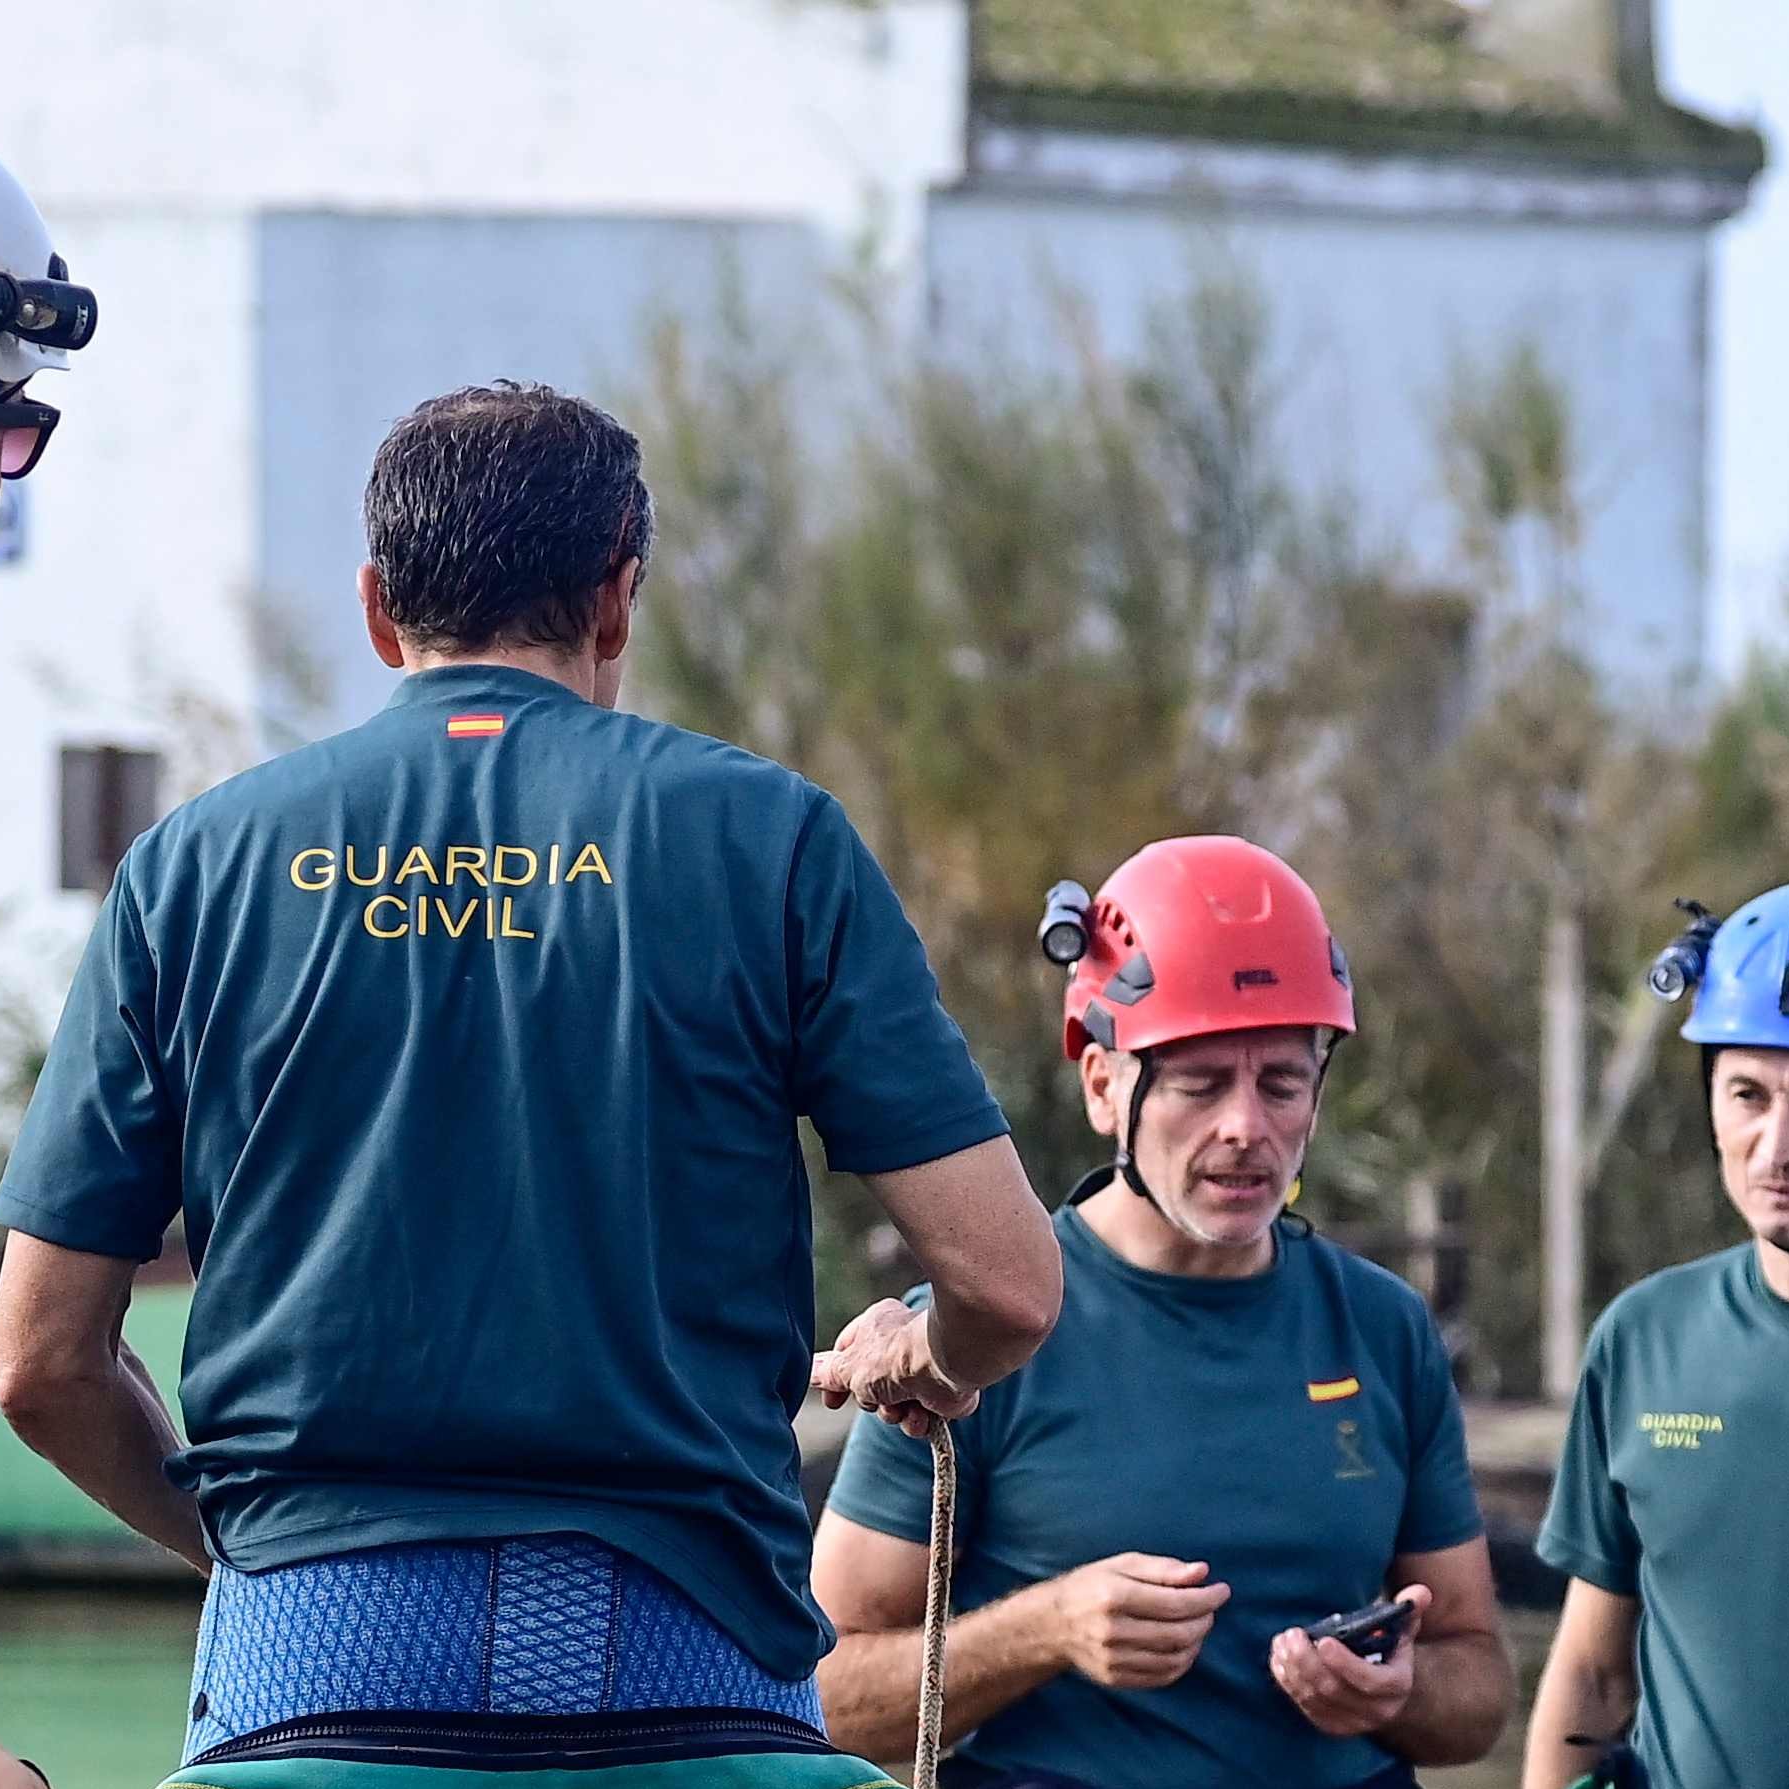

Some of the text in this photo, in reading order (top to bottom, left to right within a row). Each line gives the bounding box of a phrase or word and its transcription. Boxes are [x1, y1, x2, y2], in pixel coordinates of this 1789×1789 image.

[290, 843, 613, 890] GUARDIA
[363, 895, 536, 939] CIVIL
[1636, 1412, 1724, 1433] GUARDIA
[1652, 1429, 1700, 1450] CIVIL
